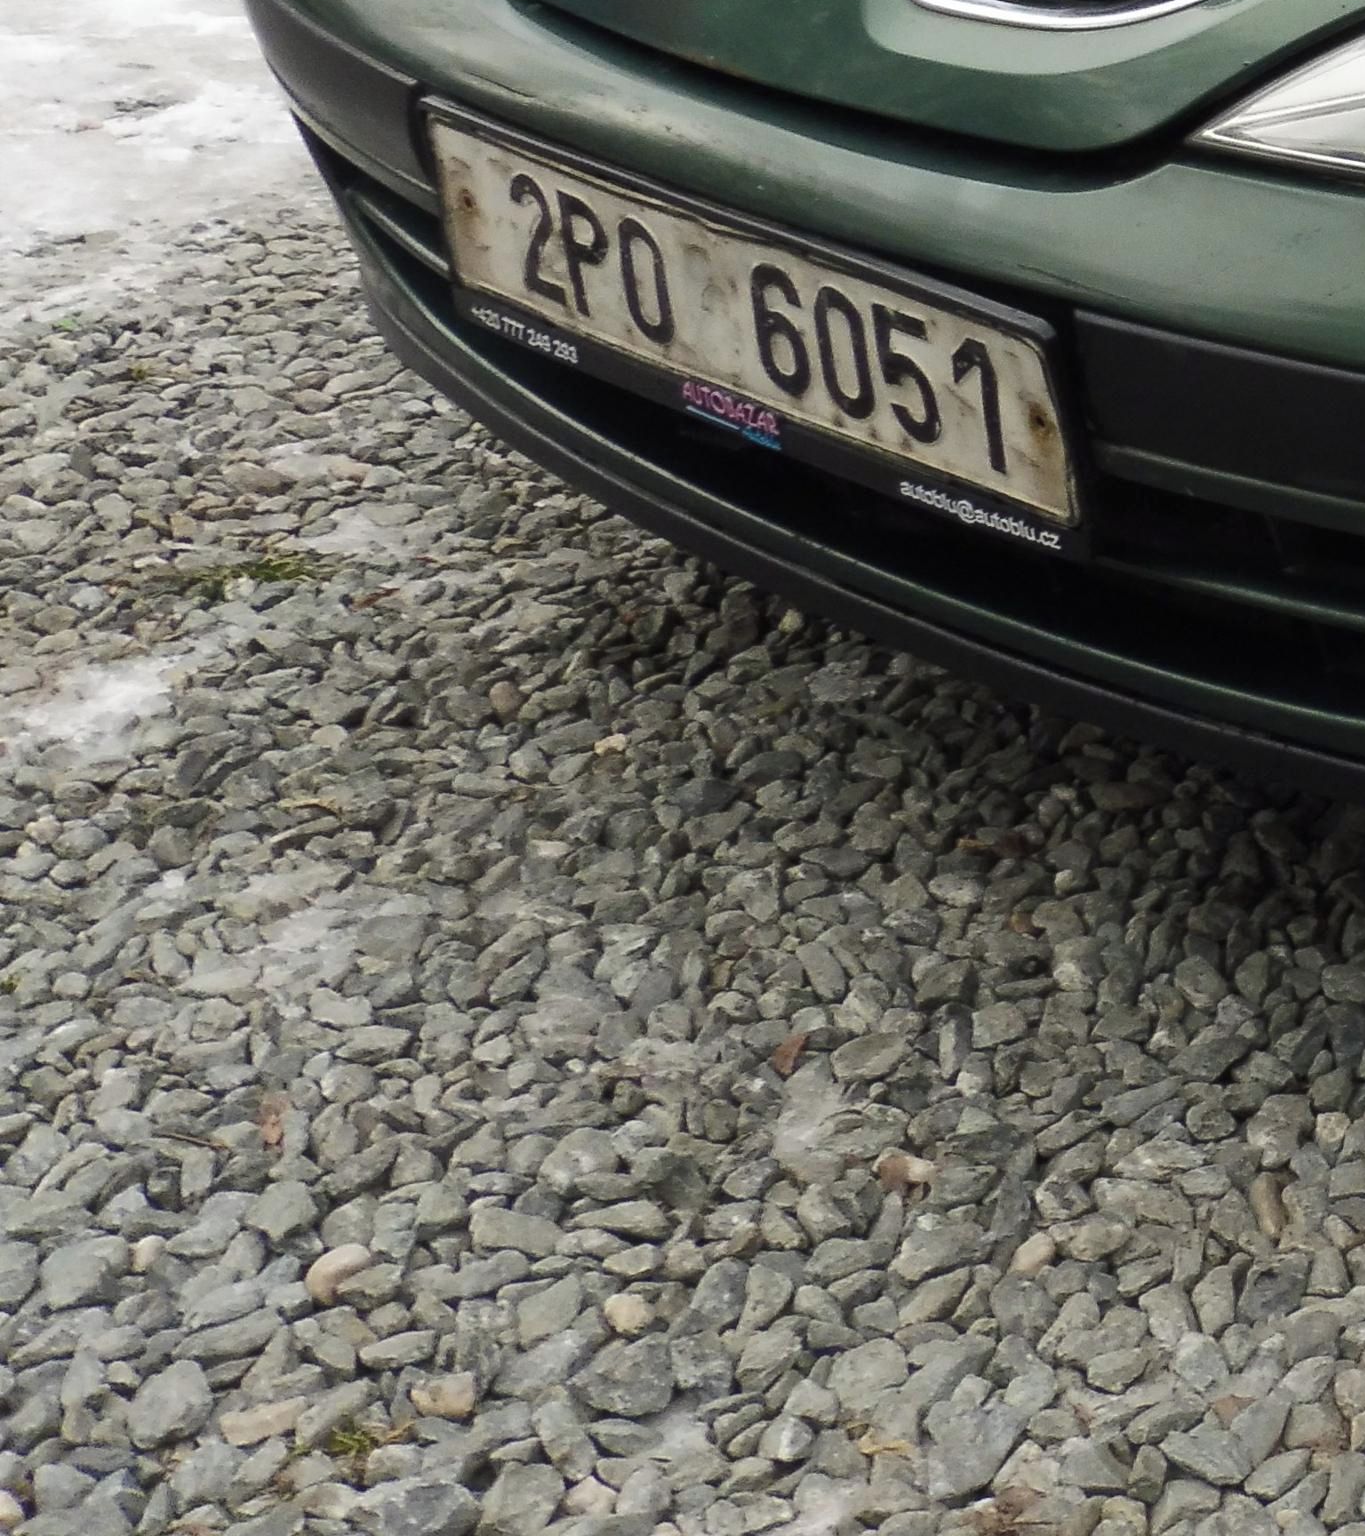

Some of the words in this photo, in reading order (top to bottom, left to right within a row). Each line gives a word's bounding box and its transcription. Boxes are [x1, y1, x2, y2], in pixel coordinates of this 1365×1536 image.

[510, 173, 675, 345] 2P0
[751, 263, 1007, 475] 6051
[899, 480, 1062, 550] autoblu@autoblu.cz
